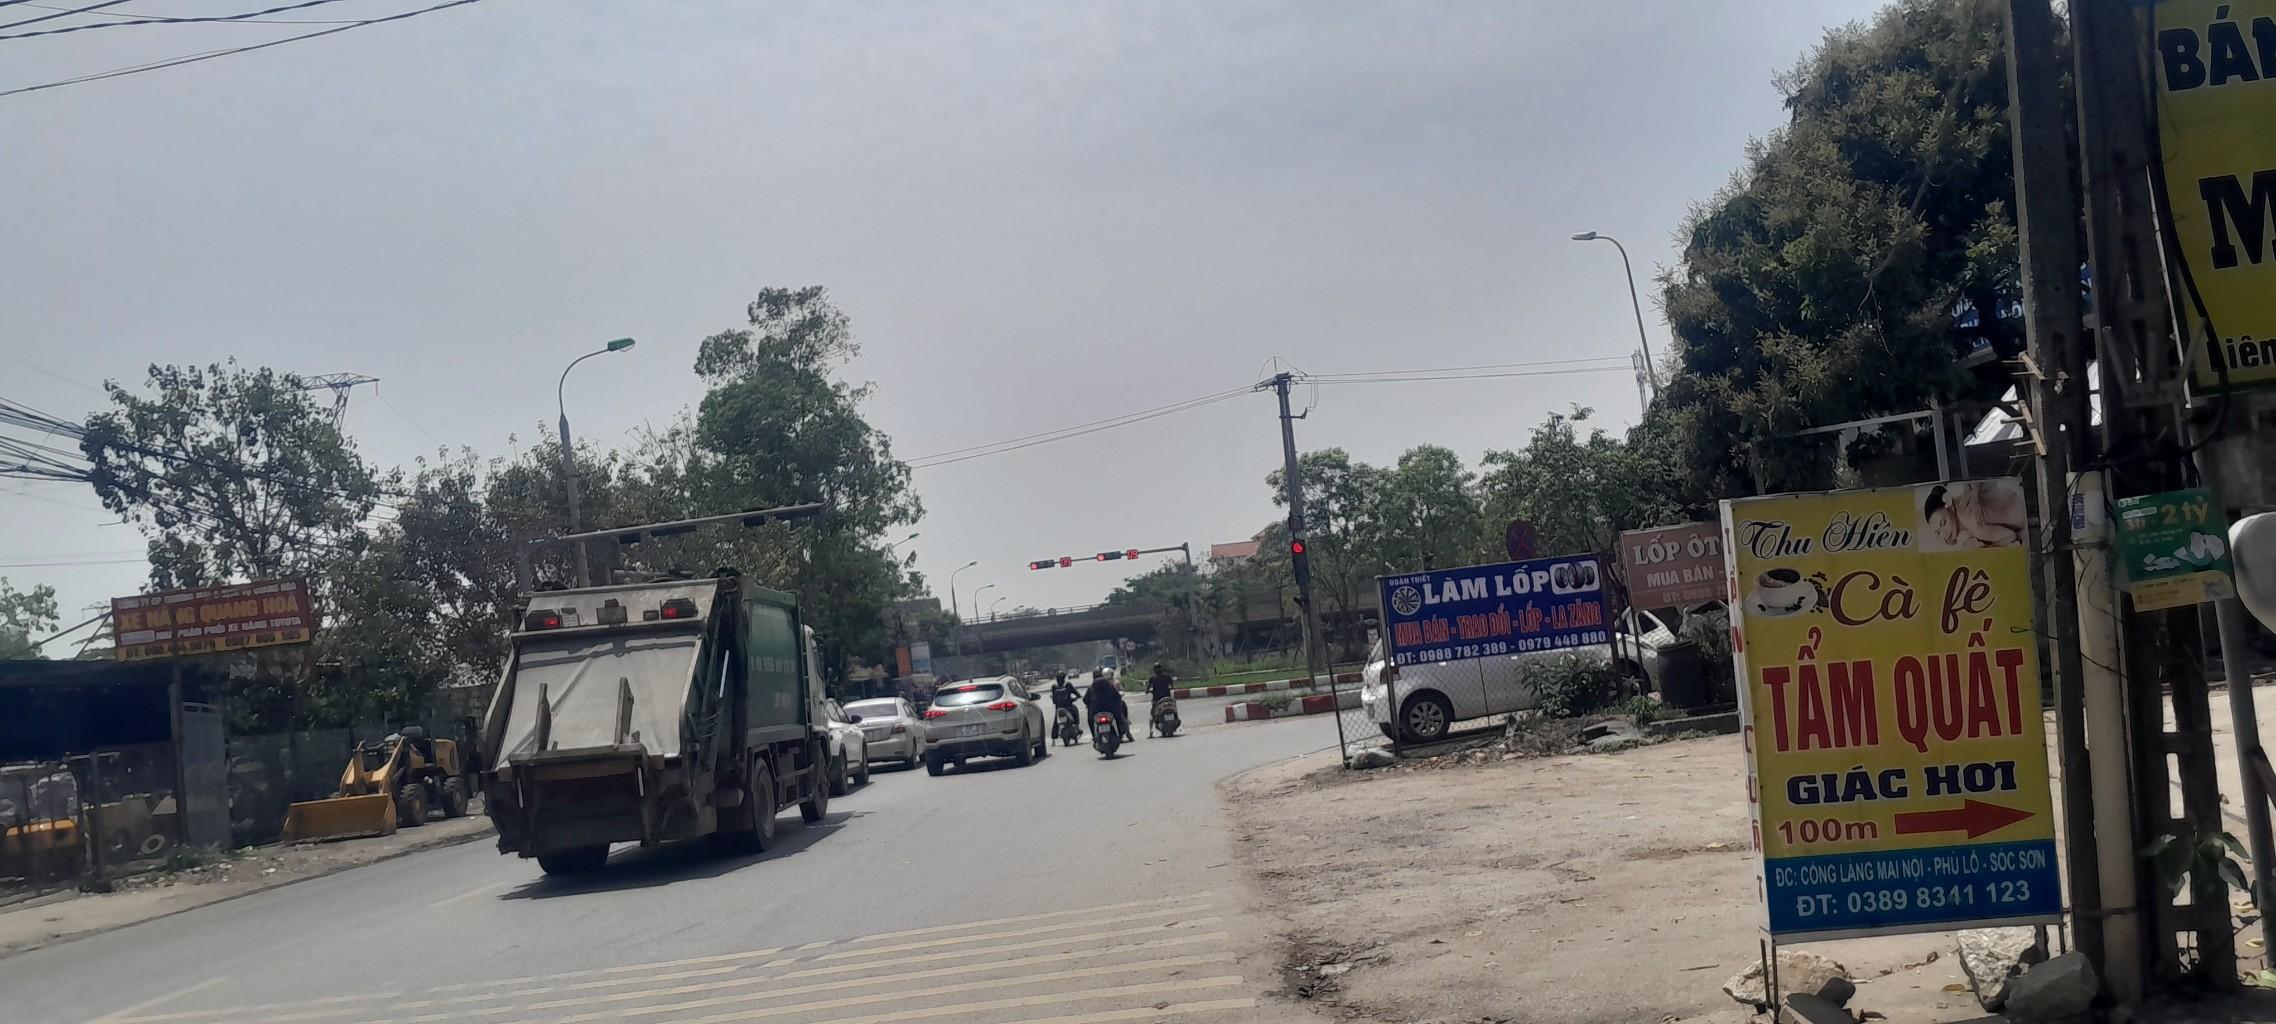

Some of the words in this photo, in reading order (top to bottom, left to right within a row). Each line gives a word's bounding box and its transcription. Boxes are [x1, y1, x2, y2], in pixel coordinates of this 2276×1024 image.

[1632, 534, 1681, 565] LỐP
[1687, 533, 1722, 558] ÔT
[1739, 520, 1813, 560] Thu
[1423, 573, 1489, 605] LÀM
[1495, 565, 1550, 597] LỐP
[1646, 569, 1680, 588] MUA
[1683, 565, 1714, 584] BÁN
[200, 600, 258, 624] QUANG
[1830, 570, 1920, 626] Cà
[1941, 566, 1996, 634] fê
[1395, 619, 1423, 646] MUA
[1424, 614, 1449, 643] BÁN
[1457, 614, 1488, 640] TRAO
[1519, 600, 1543, 634] LỐP
[1551, 606, 1567, 629] LA
[1420, 646, 1452, 662] 0988
[1455, 644, 1480, 659] 782
[1483, 641, 1507, 656] 389
[1518, 637, 1551, 652] 0979
[1554, 633, 1579, 647] 448
[1582, 630, 1607, 644] 880
[1762, 626, 1879, 752] TẨM
[1894, 618, 2024, 753] QUẤT
[1787, 765, 1909, 805] GIÁC
[1924, 761, 2017, 796] HƠI
[1777, 818, 1879, 845] 100m
[1776, 867, 1798, 887] ĐC:
[1840, 858, 1874, 883] LÀNG
[1877, 860, 1899, 880] MAI
[1902, 856, 1924, 882] NỘI
[2018, 848, 2047, 870] SƠN
[1796, 893, 1838, 917] ĐT:
[1848, 889, 1908, 914] 0389
[1916, 884, 1975, 909] 8341
[1985, 879, 2031, 904] 123
